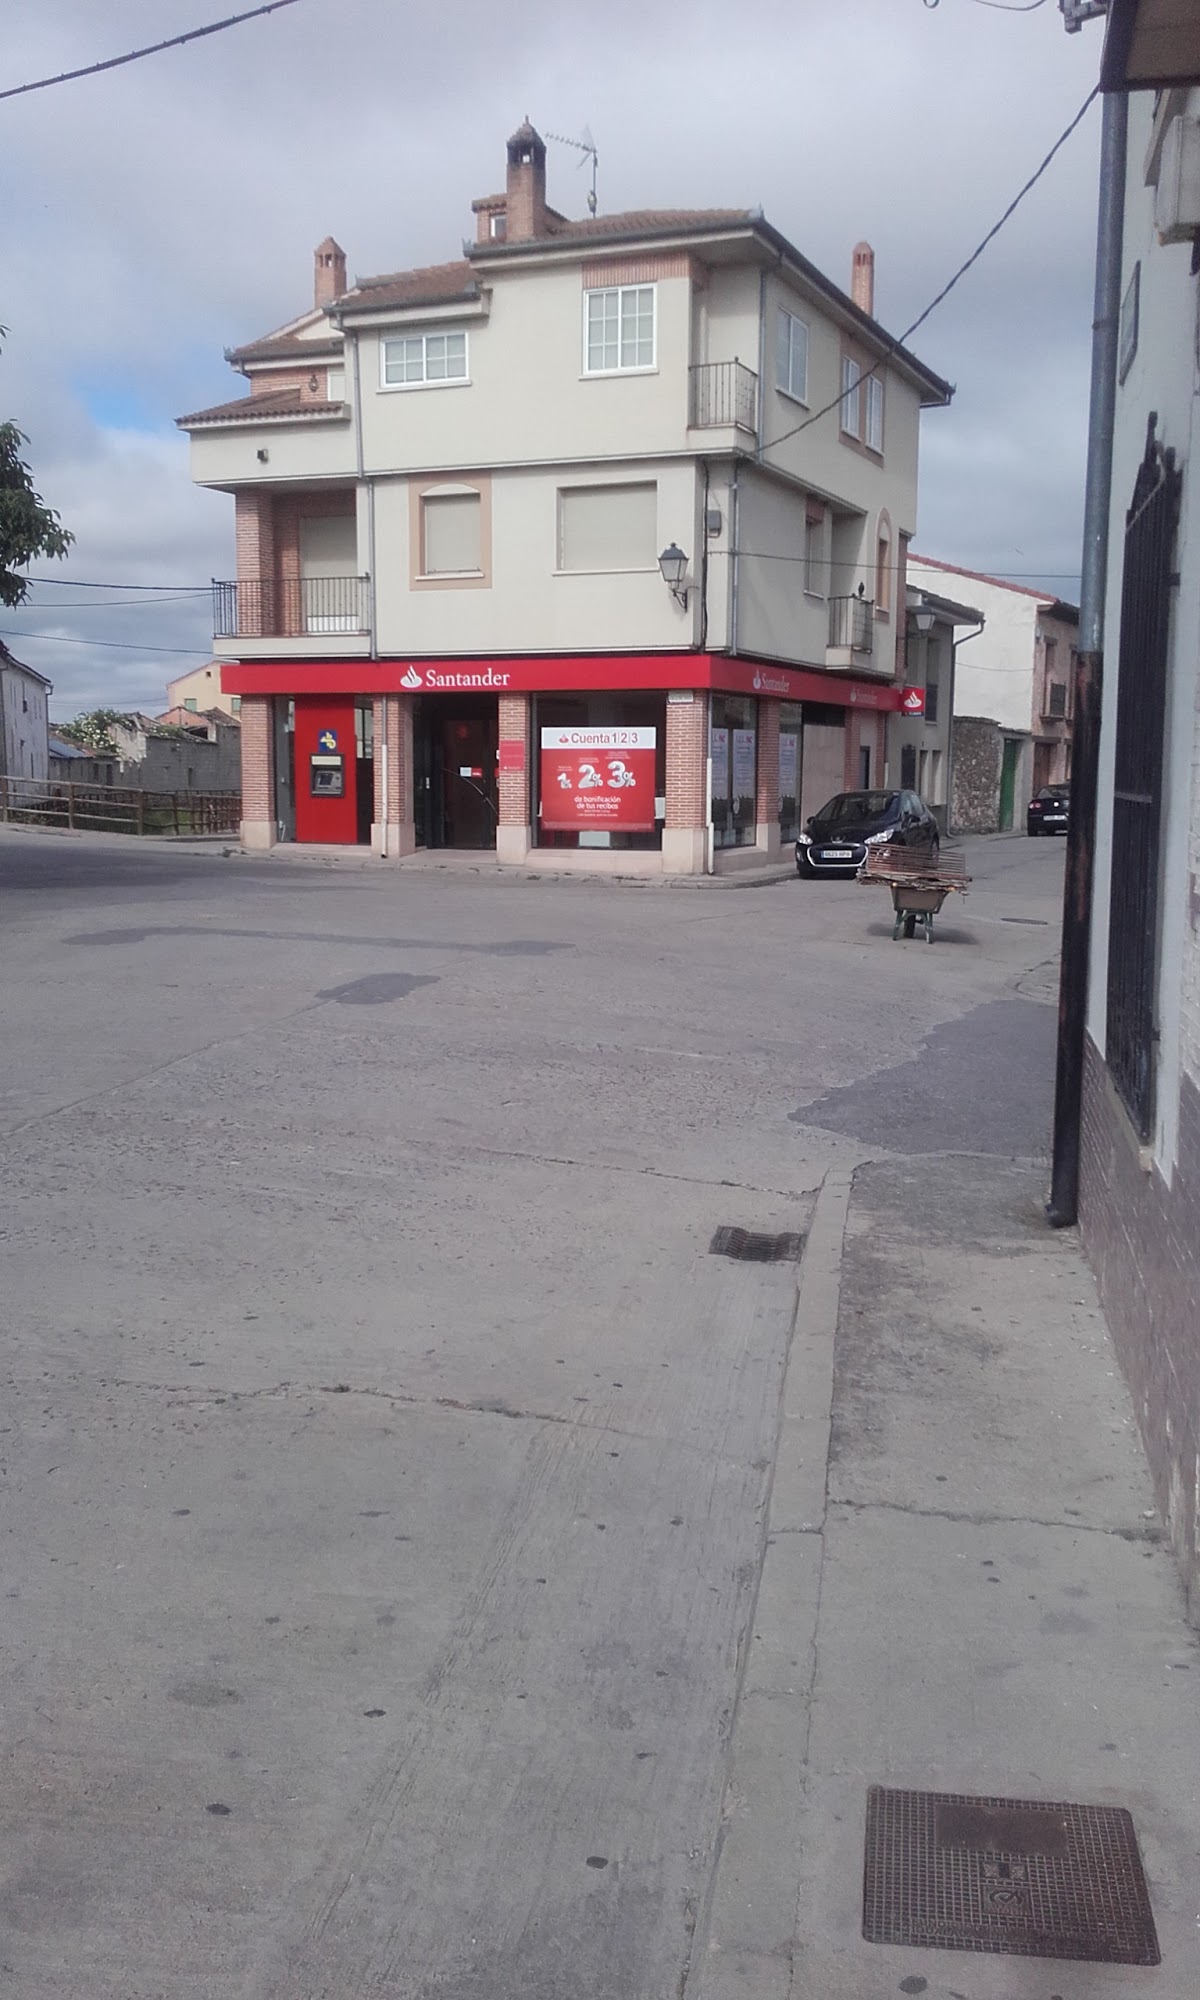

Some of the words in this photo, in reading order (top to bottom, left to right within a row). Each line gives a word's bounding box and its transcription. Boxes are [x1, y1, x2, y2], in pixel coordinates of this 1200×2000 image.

[425, 667, 511, 687] Santander
[571, 732, 610, 744] Cuenta
[576, 802, 585, 810] de
